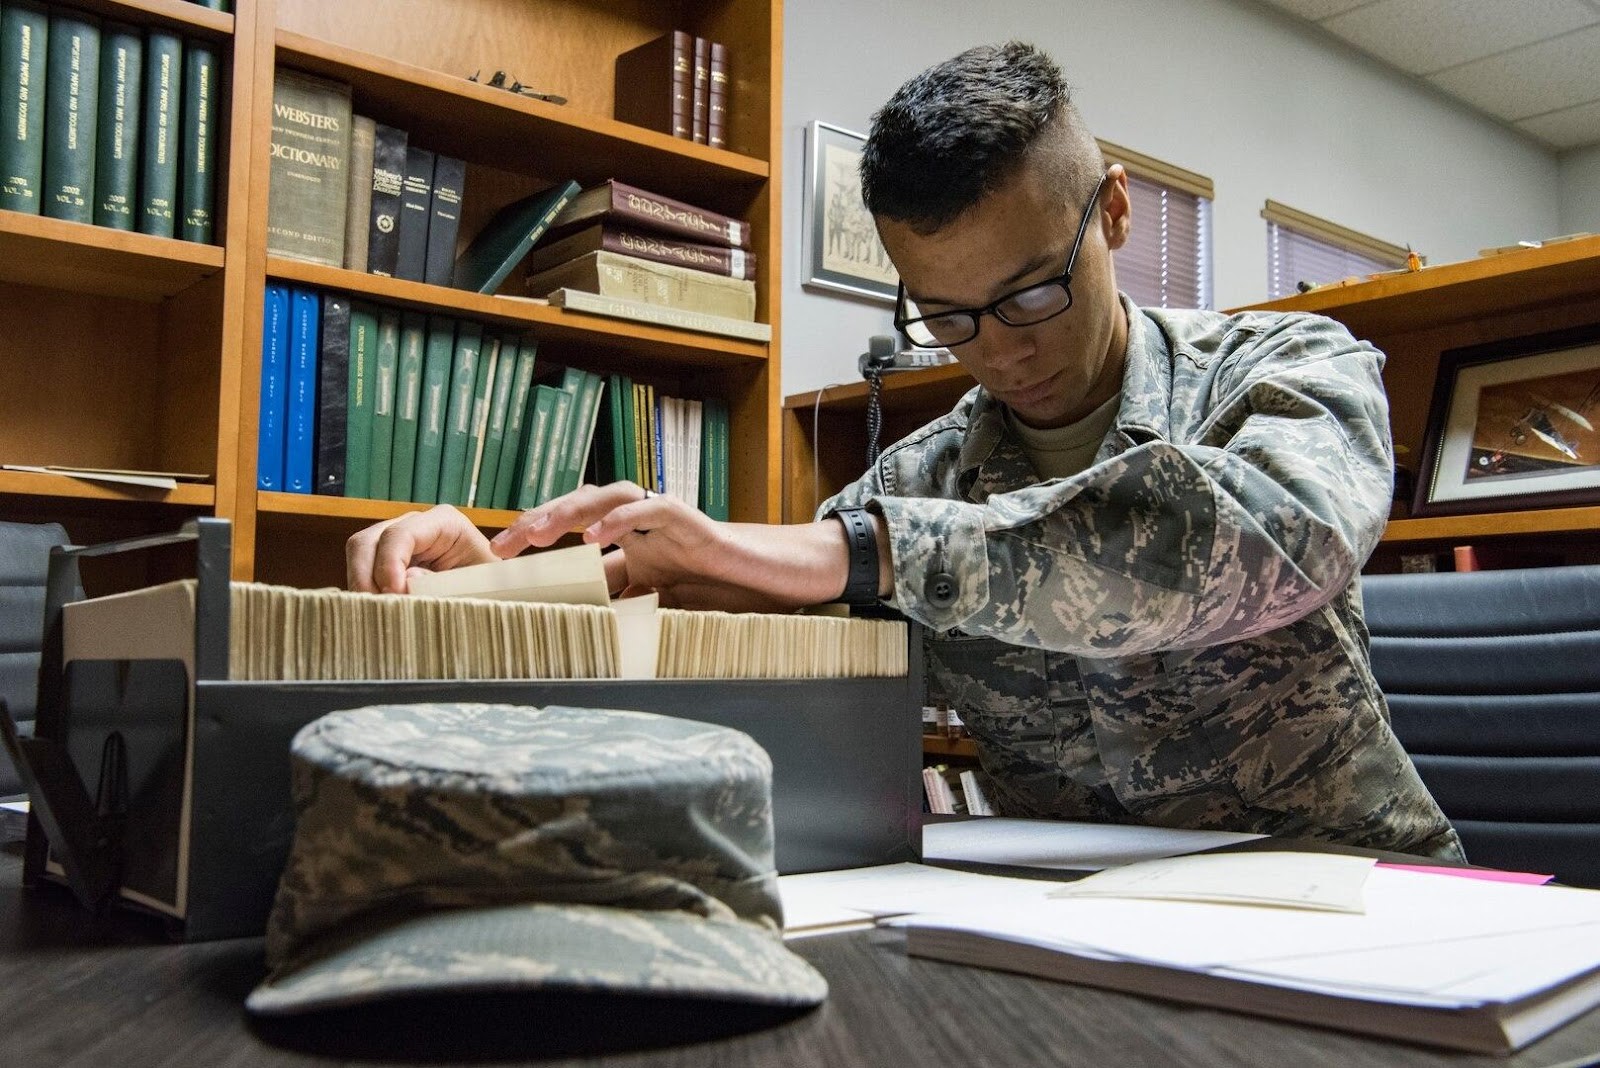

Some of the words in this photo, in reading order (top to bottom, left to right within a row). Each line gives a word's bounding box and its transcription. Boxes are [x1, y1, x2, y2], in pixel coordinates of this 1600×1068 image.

[22, 25, 31, 61] IMPORTANT
[71, 36, 81, 71] IMPORTANT
[20, 61, 30, 86] PAPERS
[117, 48, 126, 82] IMPORTANT
[160, 53, 170, 89] IMPORTANT
[19, 86, 28, 101] AND
[70, 71, 79, 95] PAPERS
[116, 83, 125, 106] PAPERS
[200, 64, 209, 98] IMPORTANT
[69, 95, 78, 111] AND
[115, 106, 124, 121] AND
[160, 89, 169, 112] PAPERS
[199, 99, 207, 121] PAPERS
[17, 101, 28, 141] DOCUMENTS
[68, 111, 78, 150] DOCUMENTS
[159, 112, 168, 127] AND
[198, 121, 206, 136] AND
[274, 103, 340, 132] WEBSTER'S
[113, 122, 124, 159] DOCUMENTS
[157, 127, 167, 164] DOCUMENTS
[197, 136, 206, 173] DOCUMENTS
[270, 142, 342, 170] DICTIONARY
